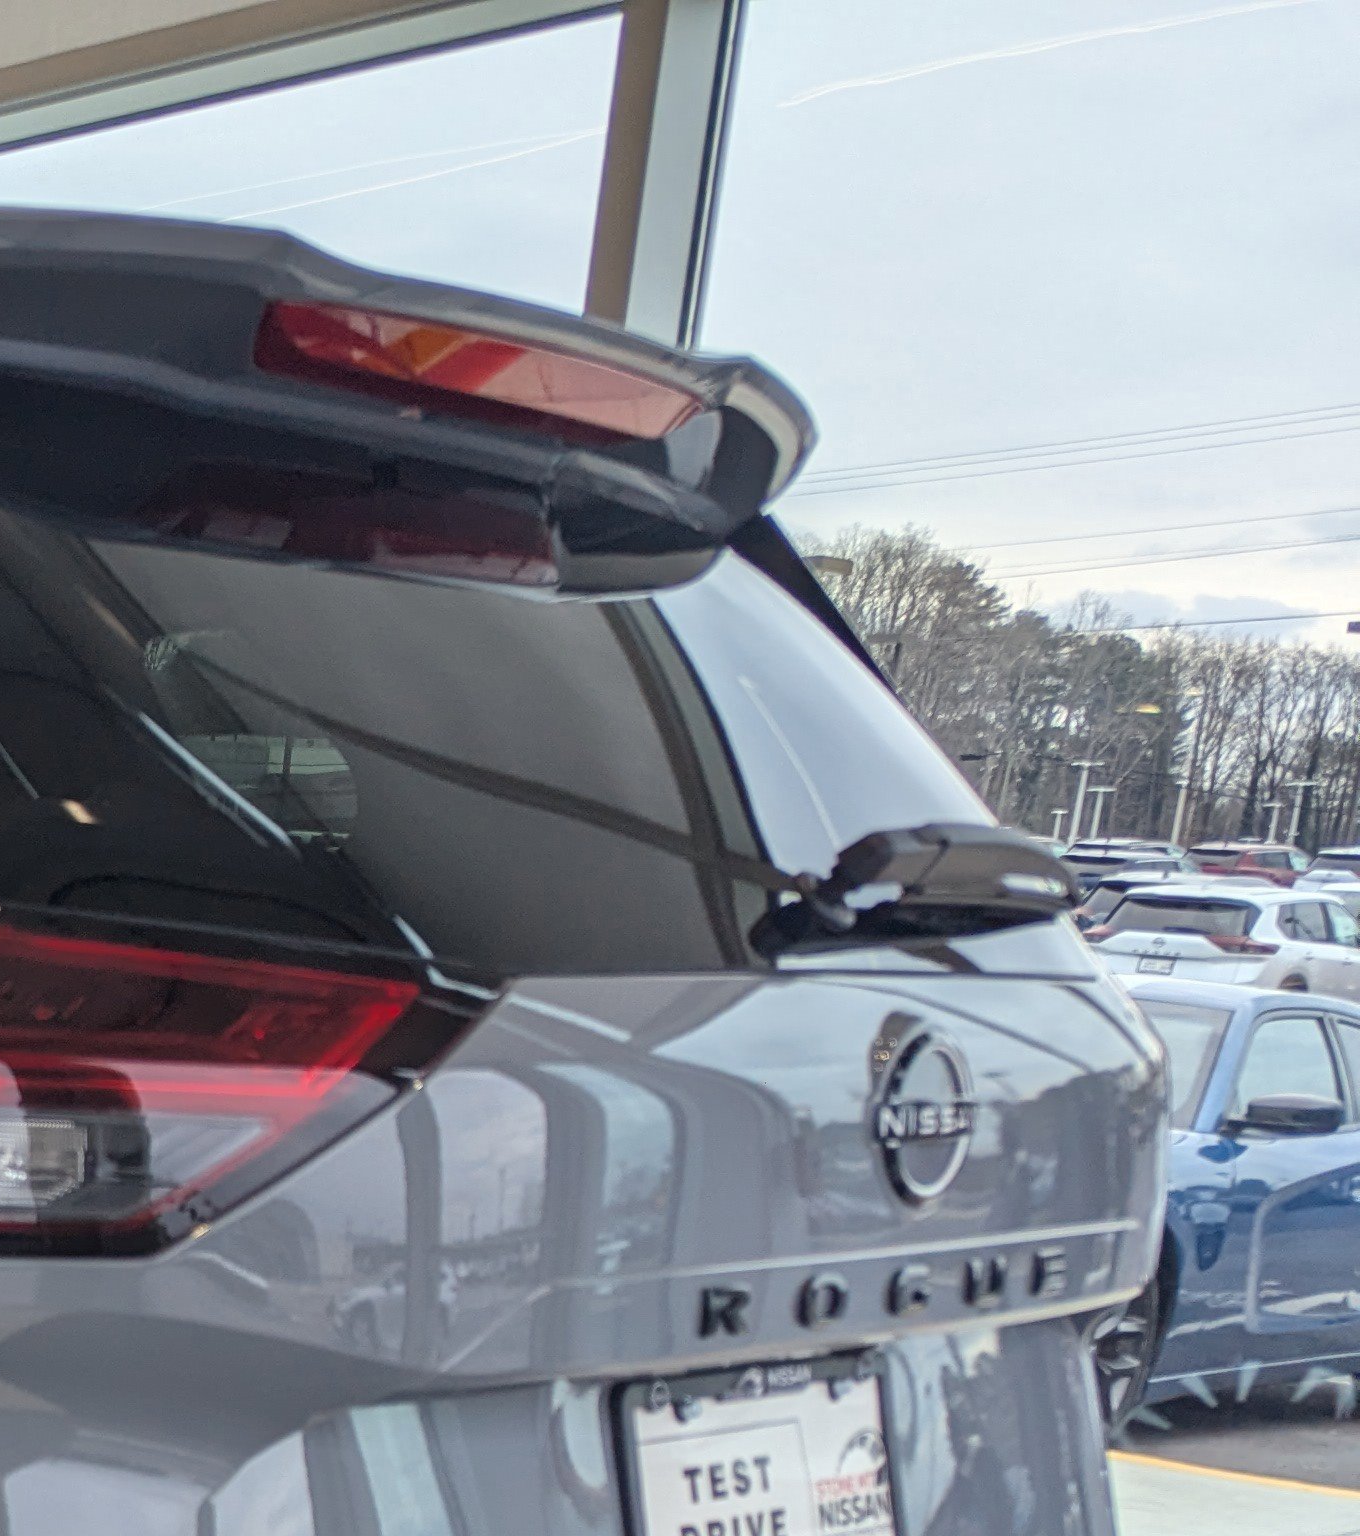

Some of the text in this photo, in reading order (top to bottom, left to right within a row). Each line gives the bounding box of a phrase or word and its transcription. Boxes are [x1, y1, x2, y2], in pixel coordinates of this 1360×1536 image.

[878, 1103, 972, 1138] NISSA
[696, 1245, 1068, 1339] ROGUE
[683, 1455, 772, 1505] TEST
[817, 1493, 893, 1529] NISSAN
